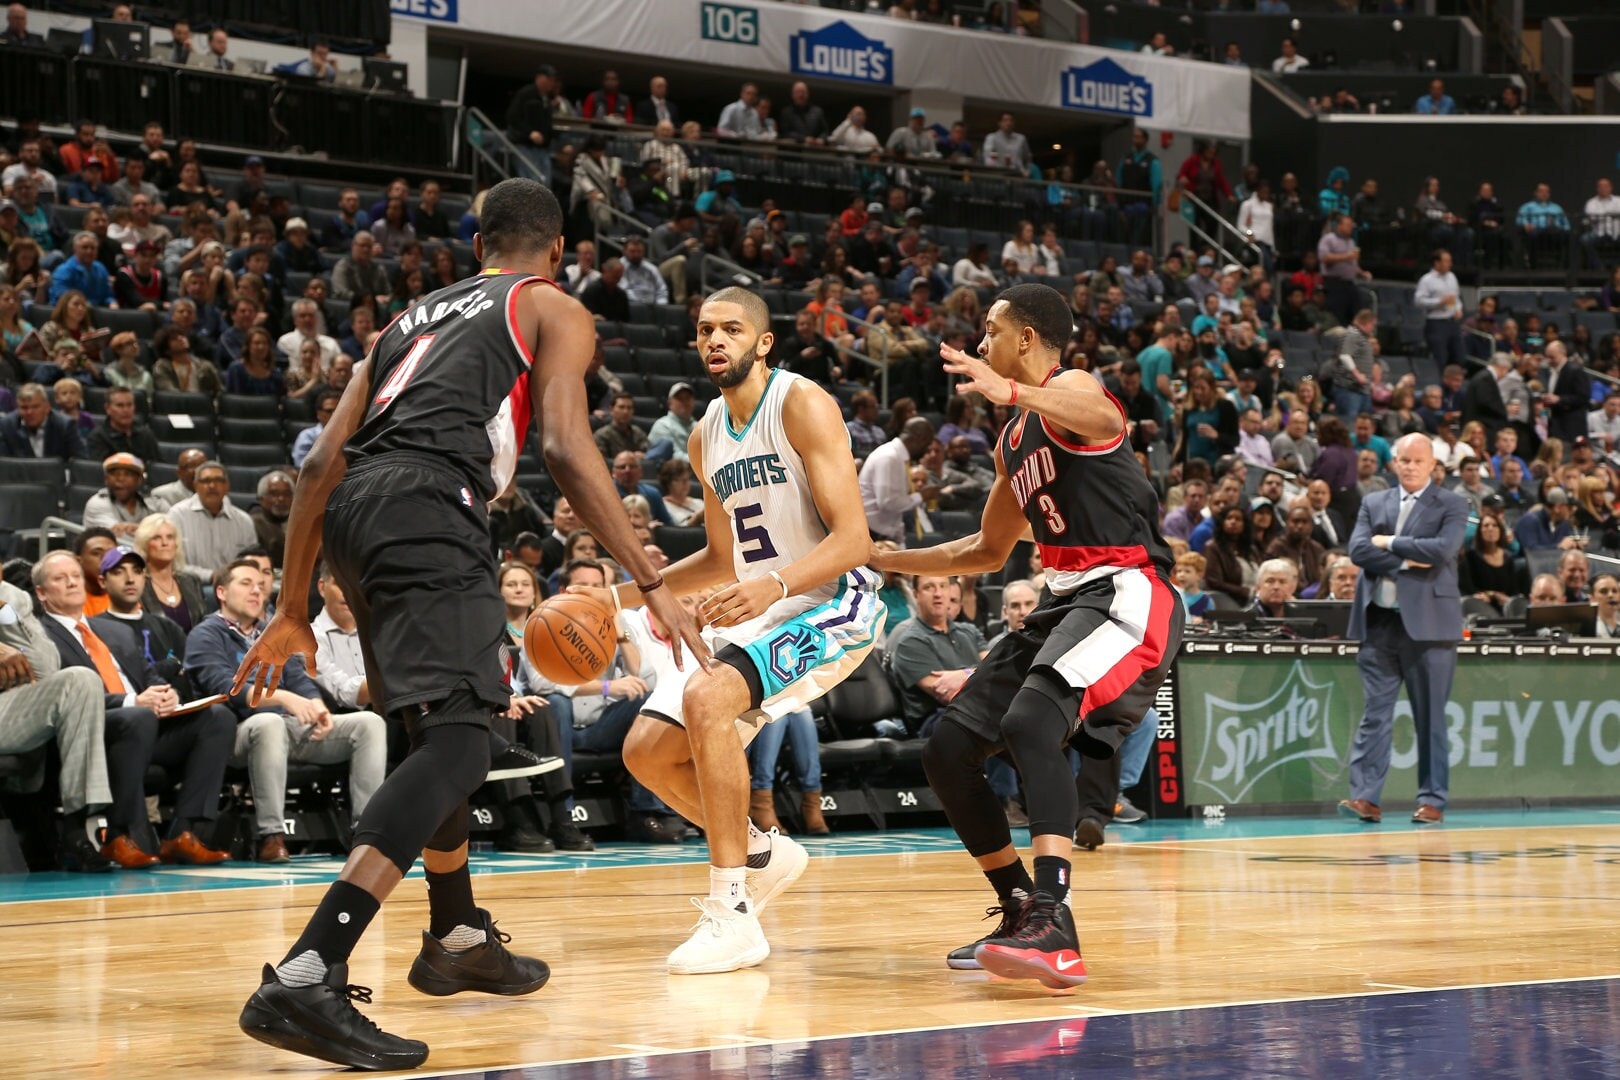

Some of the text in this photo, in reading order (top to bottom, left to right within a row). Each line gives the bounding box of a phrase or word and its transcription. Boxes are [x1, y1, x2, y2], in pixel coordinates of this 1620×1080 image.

[704, 5, 756, 42] 106
[799, 37, 886, 81] LOWE'S
[1068, 73, 1147, 114] LOWE'S
[711, 453, 788, 505] HORNETS
[734, 503, 779, 563] 5
[1038, 494, 1067, 535] 3
[560, 622, 605, 674] PALDING
[1155, 669, 1179, 804] CPI SECURI
[1211, 683, 1321, 786] Sprite
[1389, 699, 1620, 770] OBEY YO
[472, 808, 494, 825] 19
[897, 791, 918, 806] 24
